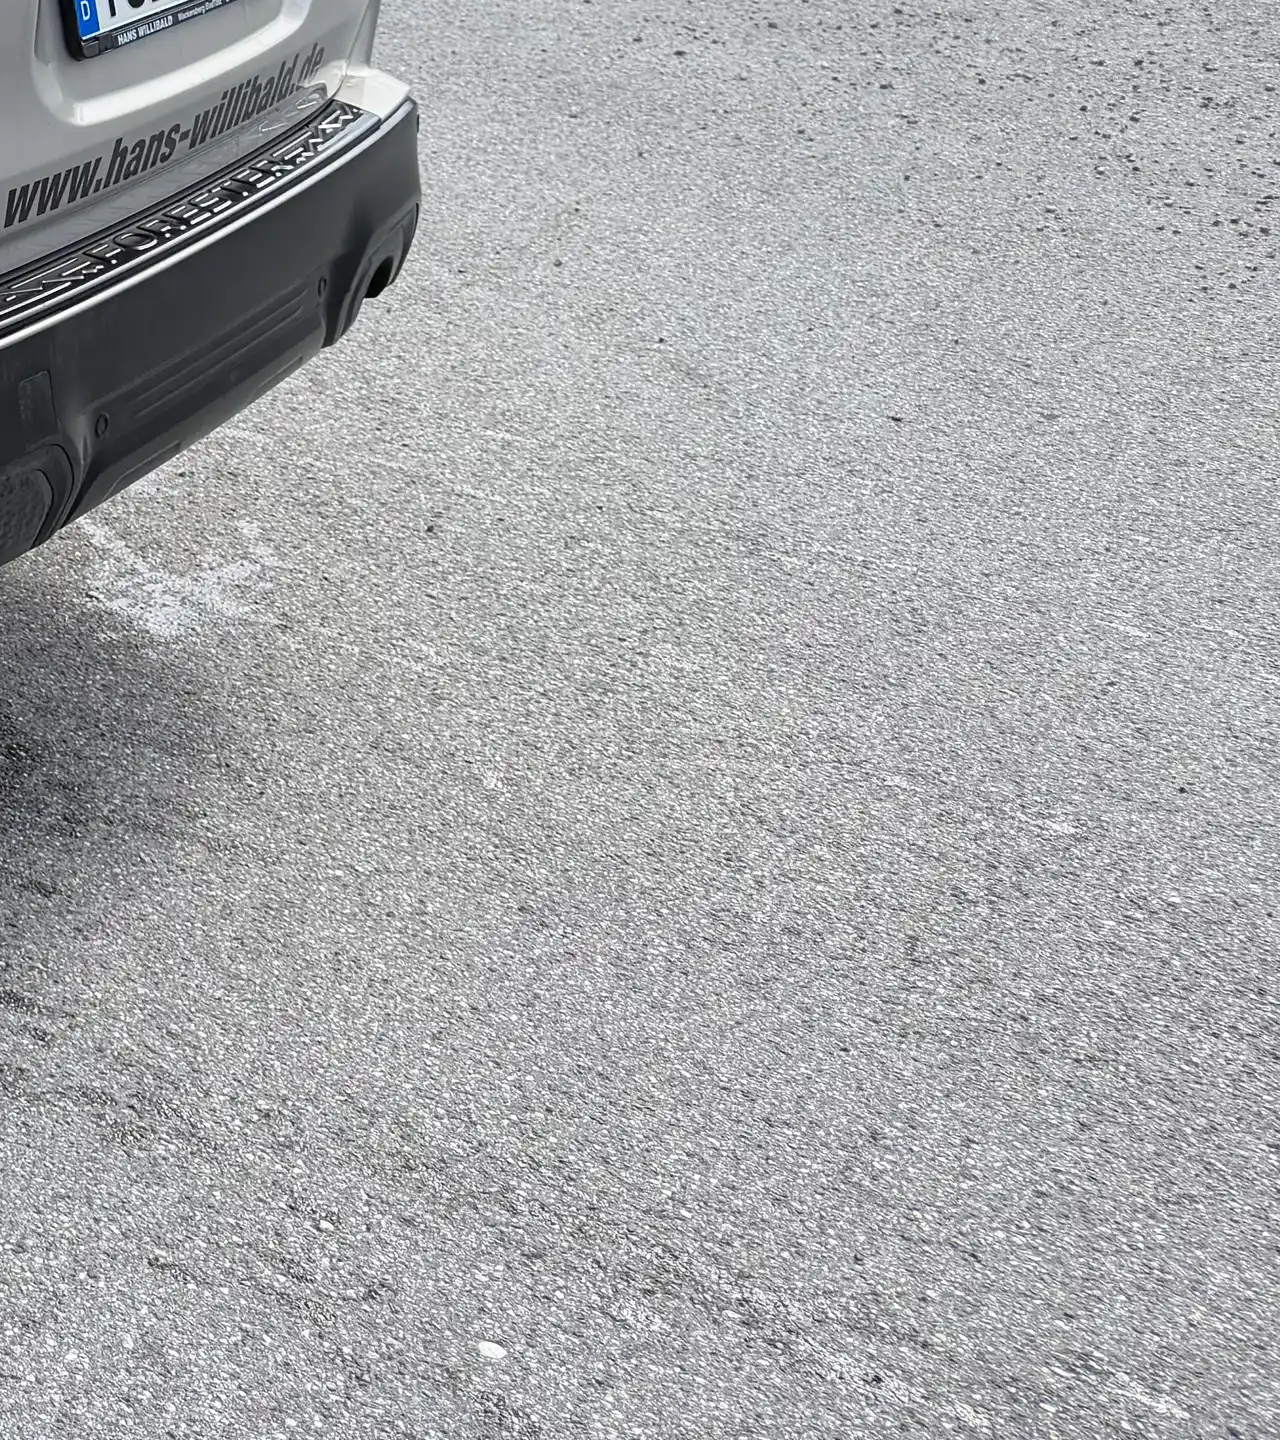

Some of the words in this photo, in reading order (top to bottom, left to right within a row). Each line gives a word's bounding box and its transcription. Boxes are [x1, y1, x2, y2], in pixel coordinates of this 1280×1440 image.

[80, 0, 91, 21] D
[117, 28, 138, 46] HANS
[137, 14, 174, 38] WILLIBALD
[3, 42, 326, 229] www.hans-willibald.de
[84, 159, 293, 265] FORESTER
